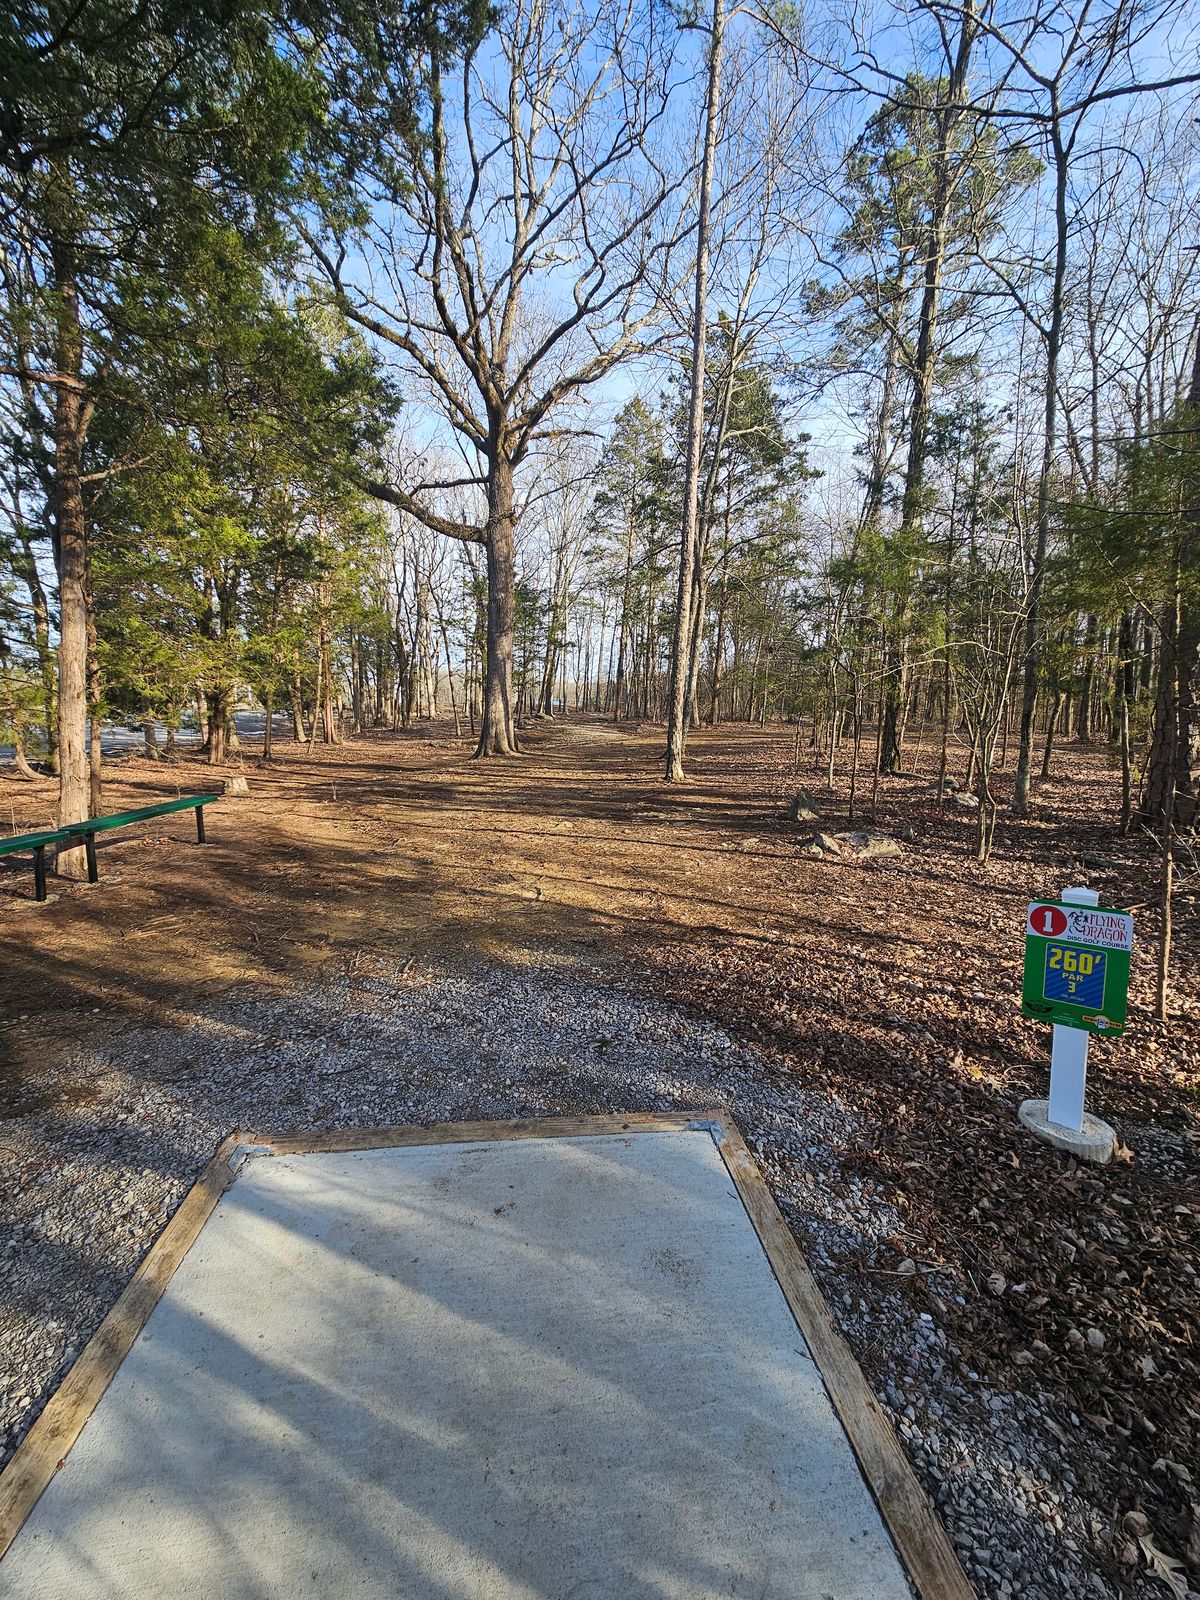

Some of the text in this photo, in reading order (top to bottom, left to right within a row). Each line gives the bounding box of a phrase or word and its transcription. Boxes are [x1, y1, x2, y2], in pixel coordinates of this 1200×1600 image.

[1043, 911, 1053, 933] 1
[1090, 914, 1126, 931] FLYING
[1083, 925, 1128, 942] DRAGON
[1102, 941, 1129, 949] COURSE
[1049, 948, 1101, 975] 260'
[1062, 972, 1084, 982] PAR
[1067, 981, 1076, 993] 3
